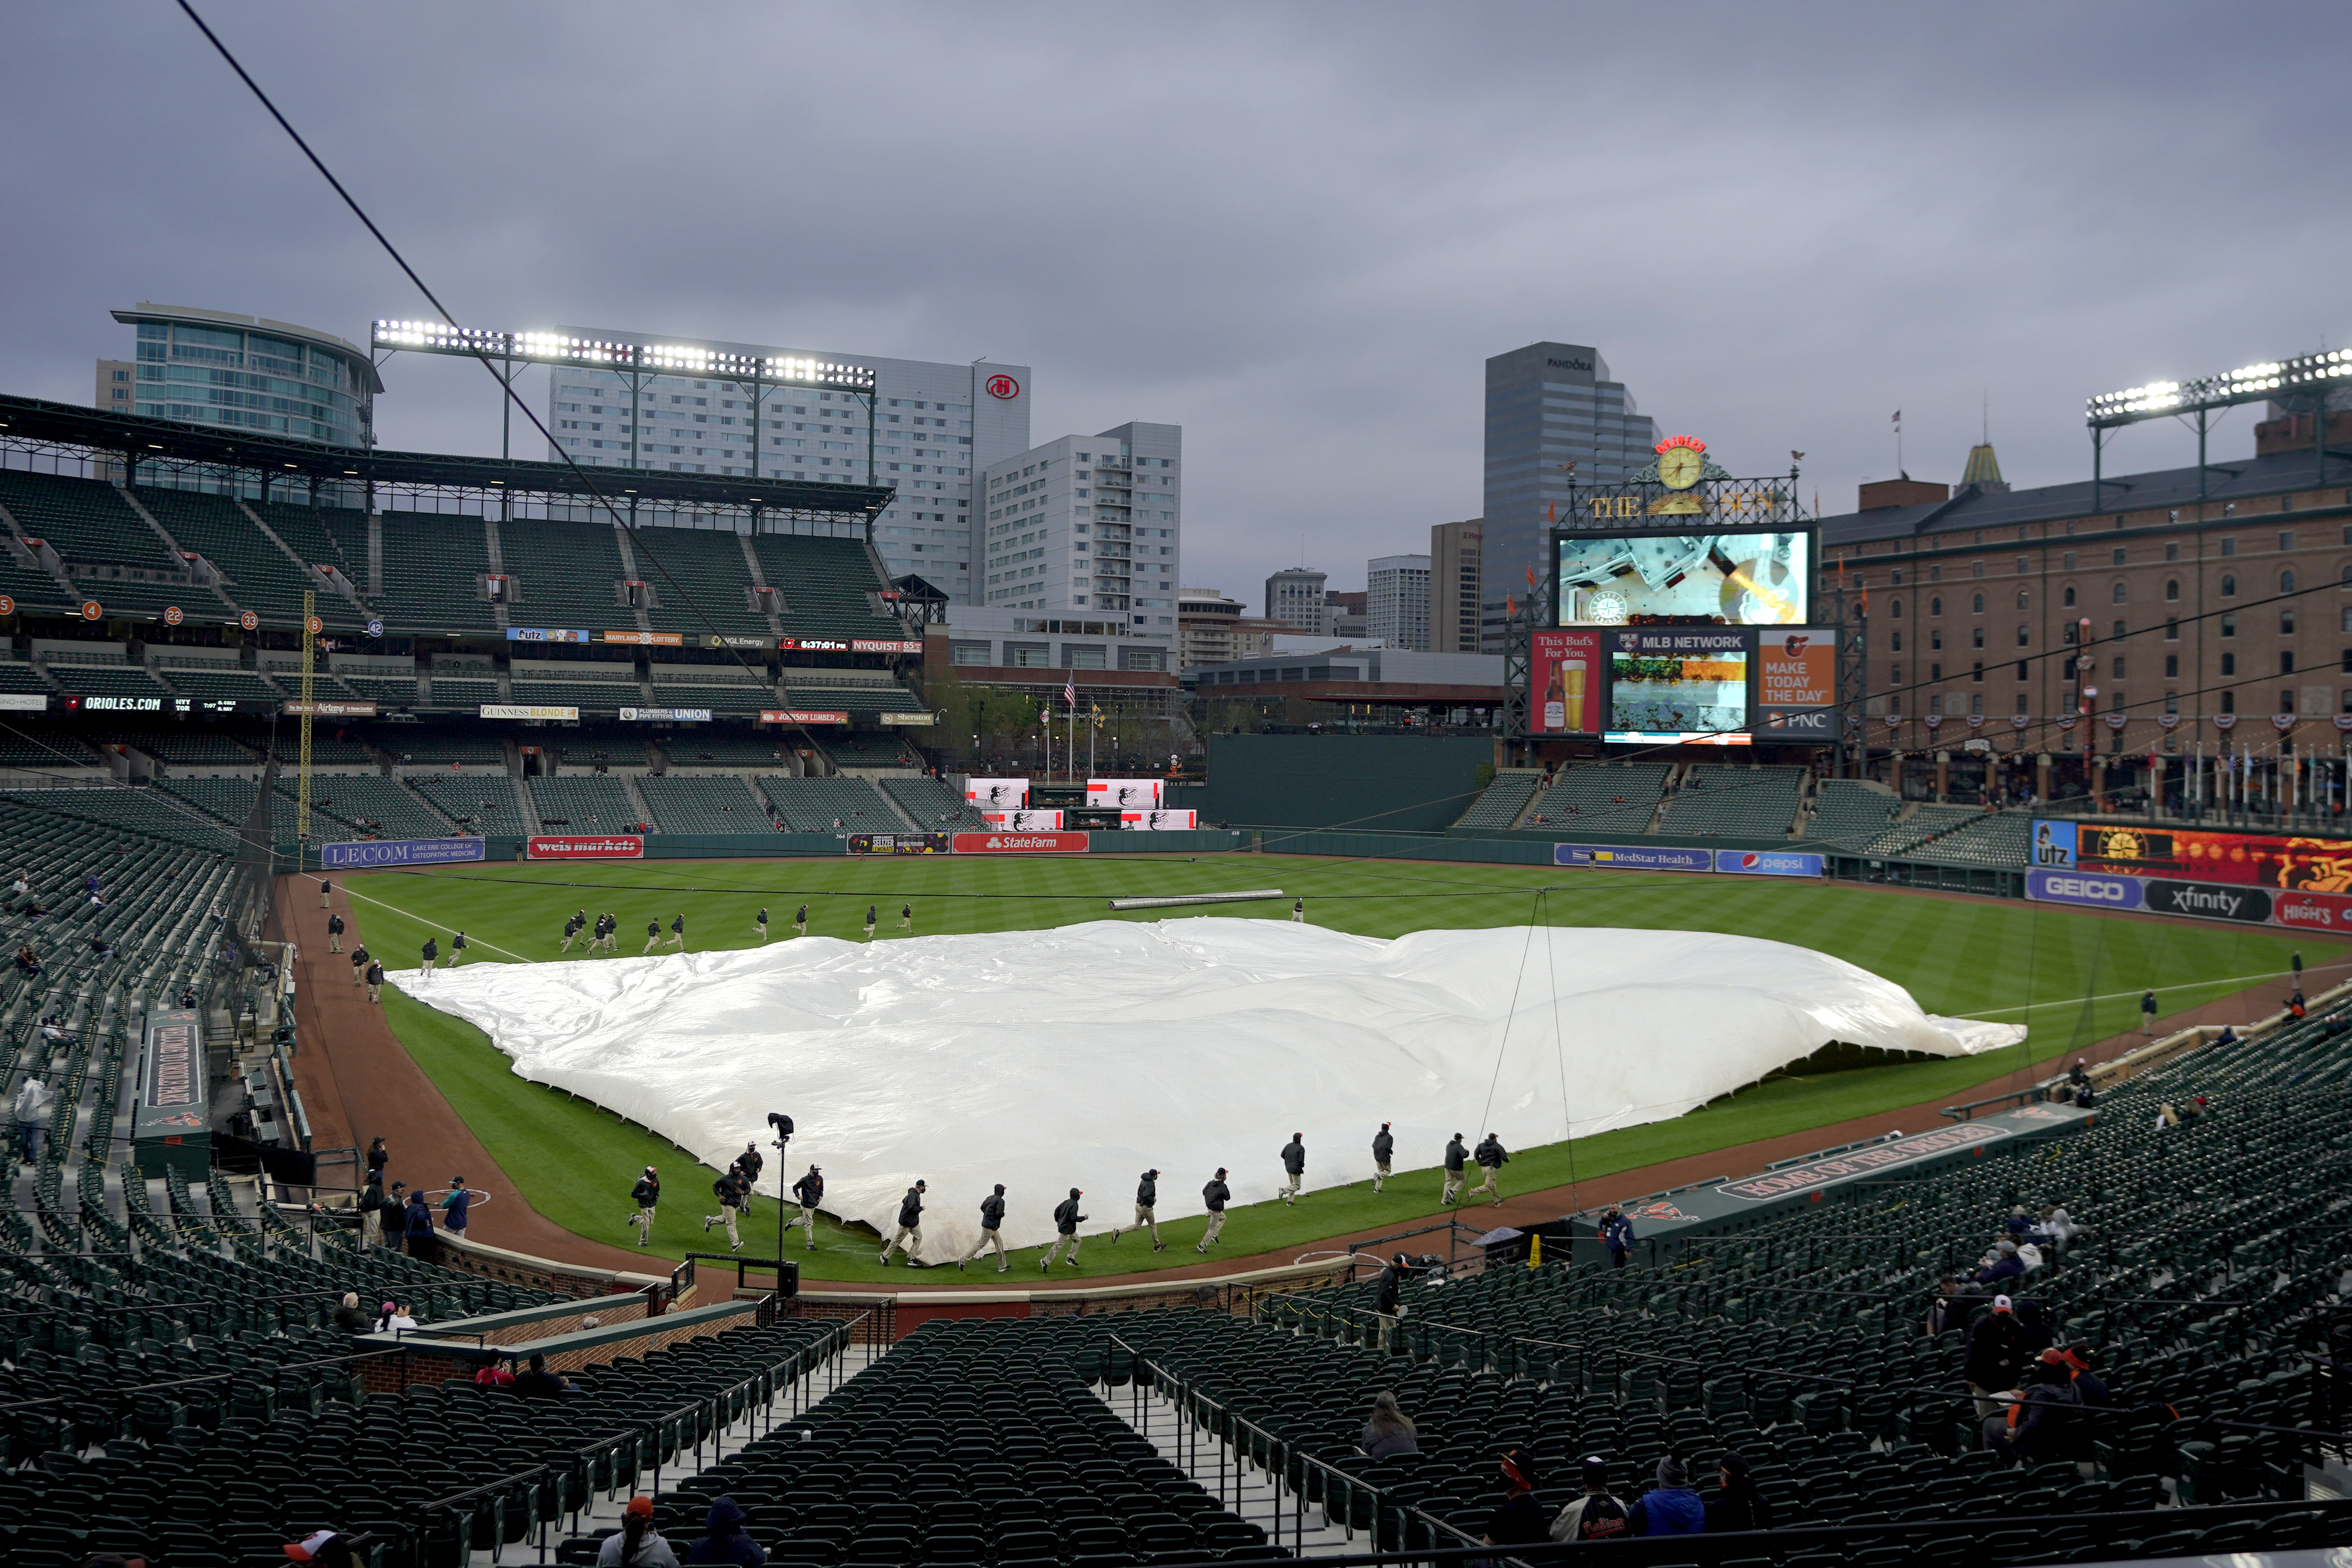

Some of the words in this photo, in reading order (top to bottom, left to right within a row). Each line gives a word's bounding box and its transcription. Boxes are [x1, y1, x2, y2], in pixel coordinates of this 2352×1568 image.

[1654, 434, 1706, 454] ORIOLES
[1589, 497, 1641, 518] THE
[1720, 491, 1774, 513] SUN
[0, 600, 8, 610] 5
[88, 606, 95, 616] 4
[167, 611, 180, 621] 22
[244, 616, 256, 626] 33
[312, 621, 318, 630] 8
[370, 624, 381, 633] 42
[801, 641, 835, 649] 6:37:01
[854, 641, 898, 651] NYQUIST
[1538, 636, 1563, 645] This
[1566, 636, 1593, 645] Bud's
[1642, 637, 1671, 647] MLB
[1675, 636, 1742, 647] NETWORK
[1545, 648, 1562, 657] For
[1564, 648, 1586, 657] You.
[1766, 662, 1807, 674] MAKE
[1765, 676, 1810, 688] TODAY
[1765, 690, 1793, 701] THE
[1797, 690, 1823, 702] DAY
[86, 697, 161, 710] ORIOLES.COM
[317, 703, 344, 713] Airtemp
[482, 707, 529, 716] GUINNESS
[531, 709, 565, 717] BLONDE
[675, 709, 710, 719] UNION
[1786, 713, 1826, 727] PNC
[536, 840, 571, 851] weis
[574, 840, 635, 851] markets
[332, 845, 409, 863] LECOM
[1614, 853, 1657, 864] MedStar
[1657, 855, 1693, 866] Health
[1763, 858, 1804, 870] pepsi
[2045, 877, 2125, 901] GEICO
[2172, 886, 2243, 916] xfinity
[2284, 904, 2332, 925] HIGH'S
[160, 1026, 189, 1053] WELCOME
[159, 1053, 189, 1062] TO
[158, 1062, 189, 1086] ORIOLE
[157, 1085, 189, 1106] PARK
[1733, 1170, 1829, 1196] HOME
[1813, 1160, 1859, 1175] OF
[1849, 1148, 1910, 1166] THE
[1894, 1126, 1995, 1154] ORIOLES
